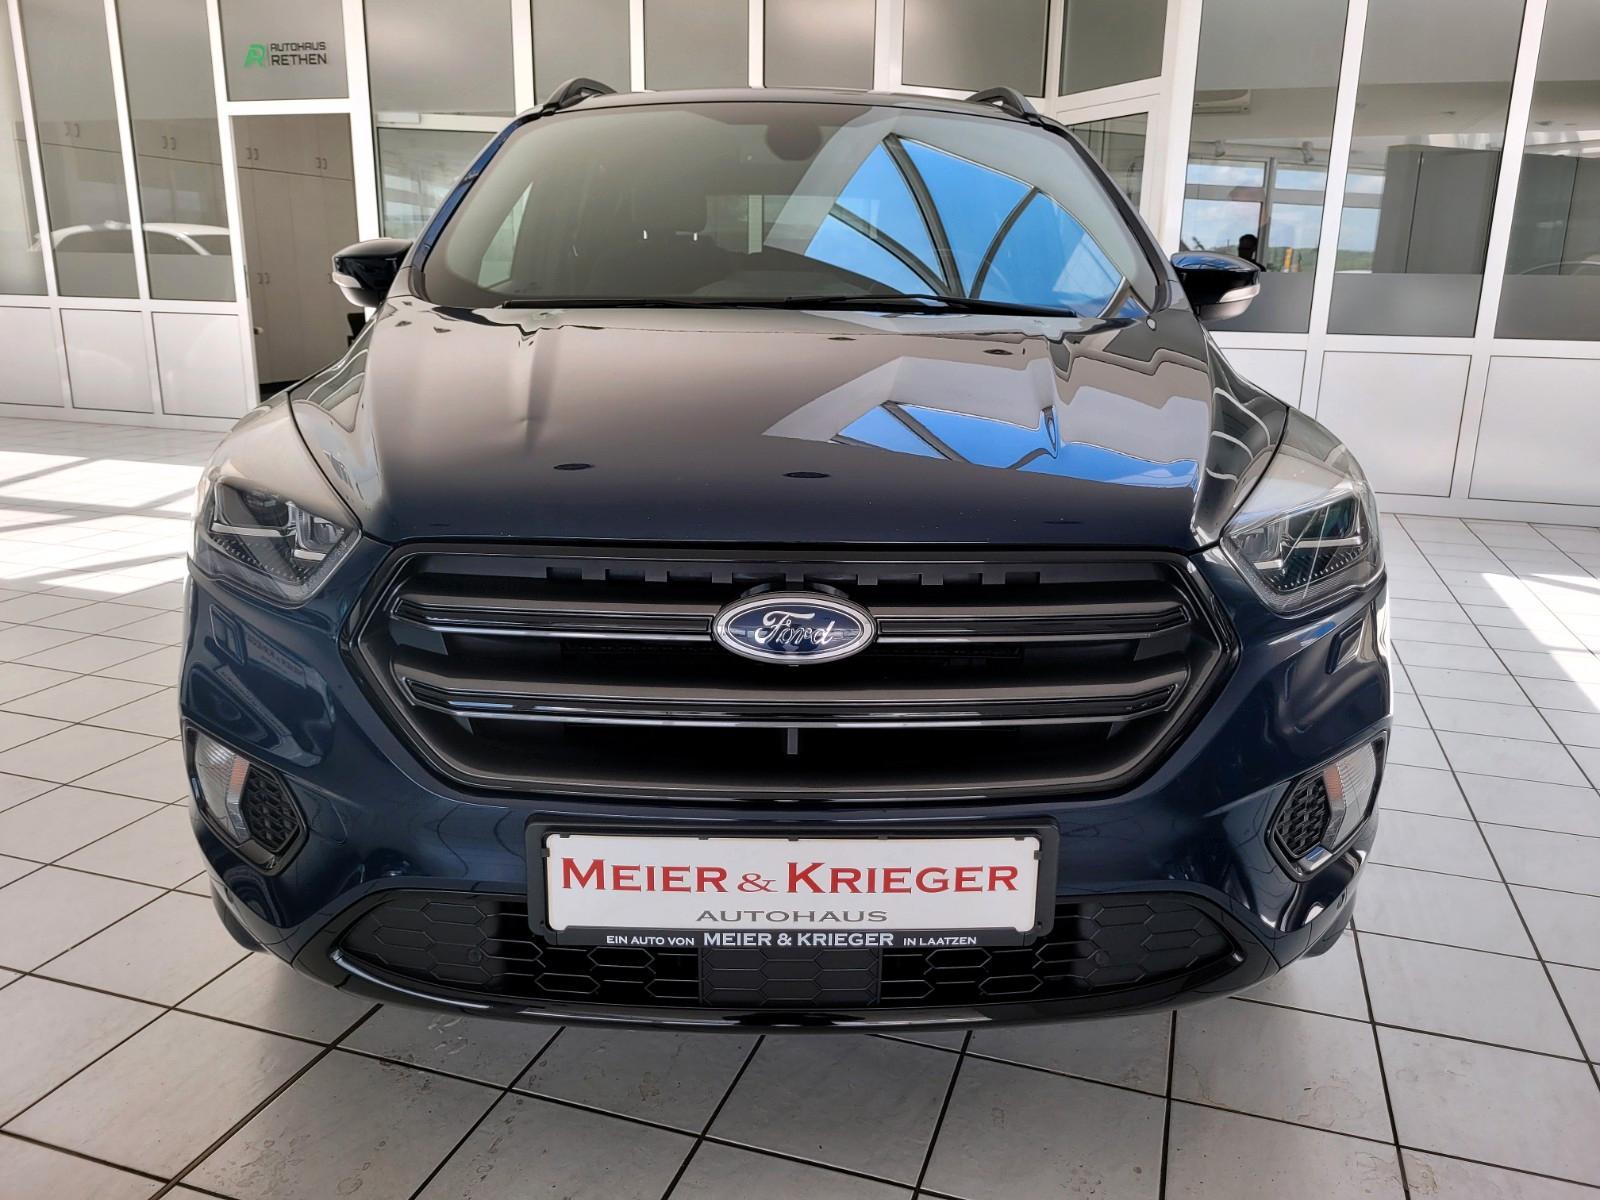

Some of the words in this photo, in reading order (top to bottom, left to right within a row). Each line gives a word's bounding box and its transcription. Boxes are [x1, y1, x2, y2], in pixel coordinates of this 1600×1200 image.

[270, 42, 326, 52] AUTOHAUS
[271, 53, 327, 66] RETHEN
[754, 610, 835, 645] Ford
[562, 857, 728, 893] MEIER
[737, 873, 779, 893] &
[786, 862, 1018, 894] KRIEGER
[696, 910, 888, 922] AUTOHAUS
[606, 935, 628, 945] EIN
[631, 935, 665, 946] AUTO
[668, 937, 695, 946] VON
[703, 933, 773, 946] MEIER
[777, 933, 792, 946] &
[797, 933, 894, 947] KRIEGER
[903, 937, 917, 946] IN
[920, 936, 977, 946] LAATZEN
